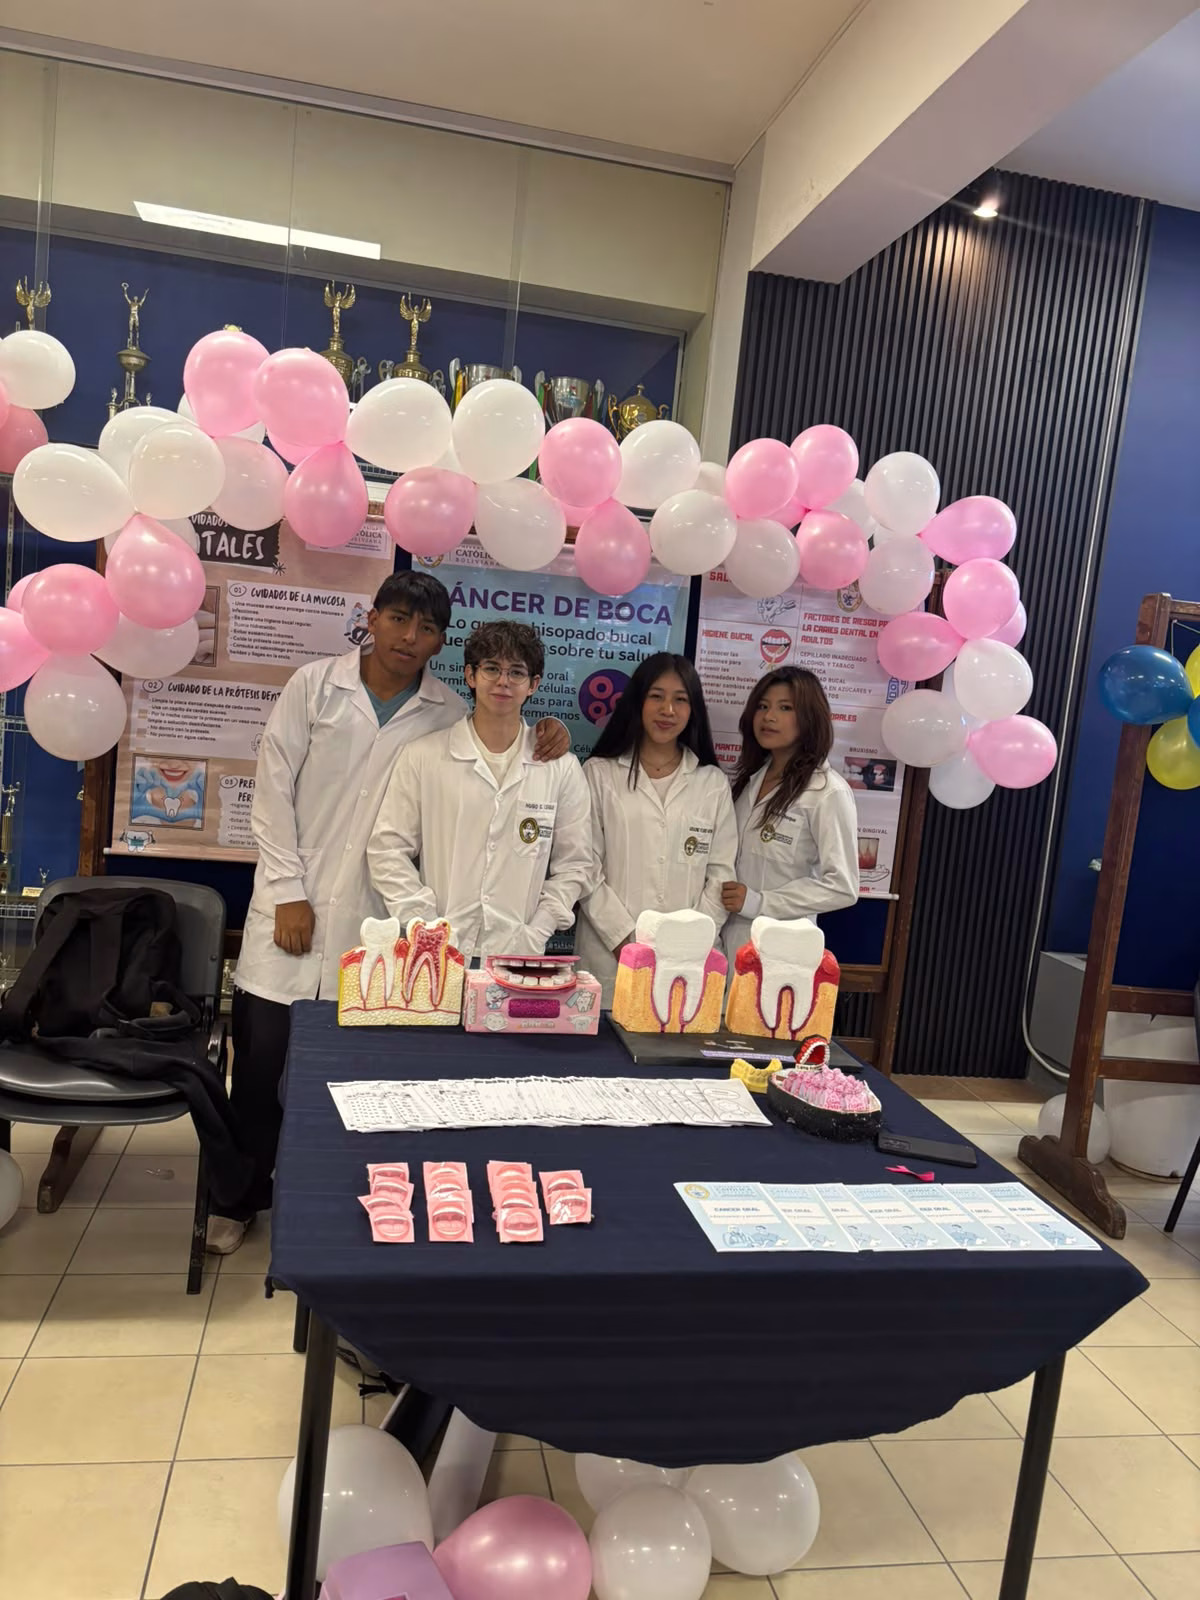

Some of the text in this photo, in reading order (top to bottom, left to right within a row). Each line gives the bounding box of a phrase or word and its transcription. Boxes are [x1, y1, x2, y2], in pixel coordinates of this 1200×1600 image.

[360, 530, 382, 538] ÓLICA
[197, 530, 265, 560] TALES
[455, 557, 500, 567] BOLIVIANA
[709, 571, 731, 583] SAL
[233, 586, 346, 608] 01 CUIDADOS DE LA MUCOSA
[450, 581, 673, 626] ÁNCER DE BOCA
[803, 612, 878, 628] FACTORES DE RIESGO
[531, 621, 606, 642] hisopado
[610, 628, 652, 645] bucal
[702, 629, 754, 641] HIGIENE BUCAL
[802, 624, 812, 632] LA
[840, 628, 868, 638] DENTAL
[869, 630, 879, 638] EN
[801, 635, 834, 646] ADULTOS
[549, 643, 594, 658] sobre
[598, 646, 614, 660] tu
[618, 648, 651, 662] salu
[800, 651, 868, 662] CEPILLADO INADECUADO
[430, 660, 446, 671] Un
[832, 662, 855, 670] TABACO
[546, 671, 568, 681] oral
[147, 681, 158, 689] 02
[168, 682, 200, 694] CUIDADO
[201, 684, 212, 695] DE
[214, 686, 224, 696] LA
[225, 686, 260, 700] PRÓTESIS
[538, 682, 577, 694] células
[548, 698, 573, 708] para
[524, 710, 580, 720] empranos
[849, 746, 878, 754] BRUXISMO
[715, 754, 737, 762] ALUD
